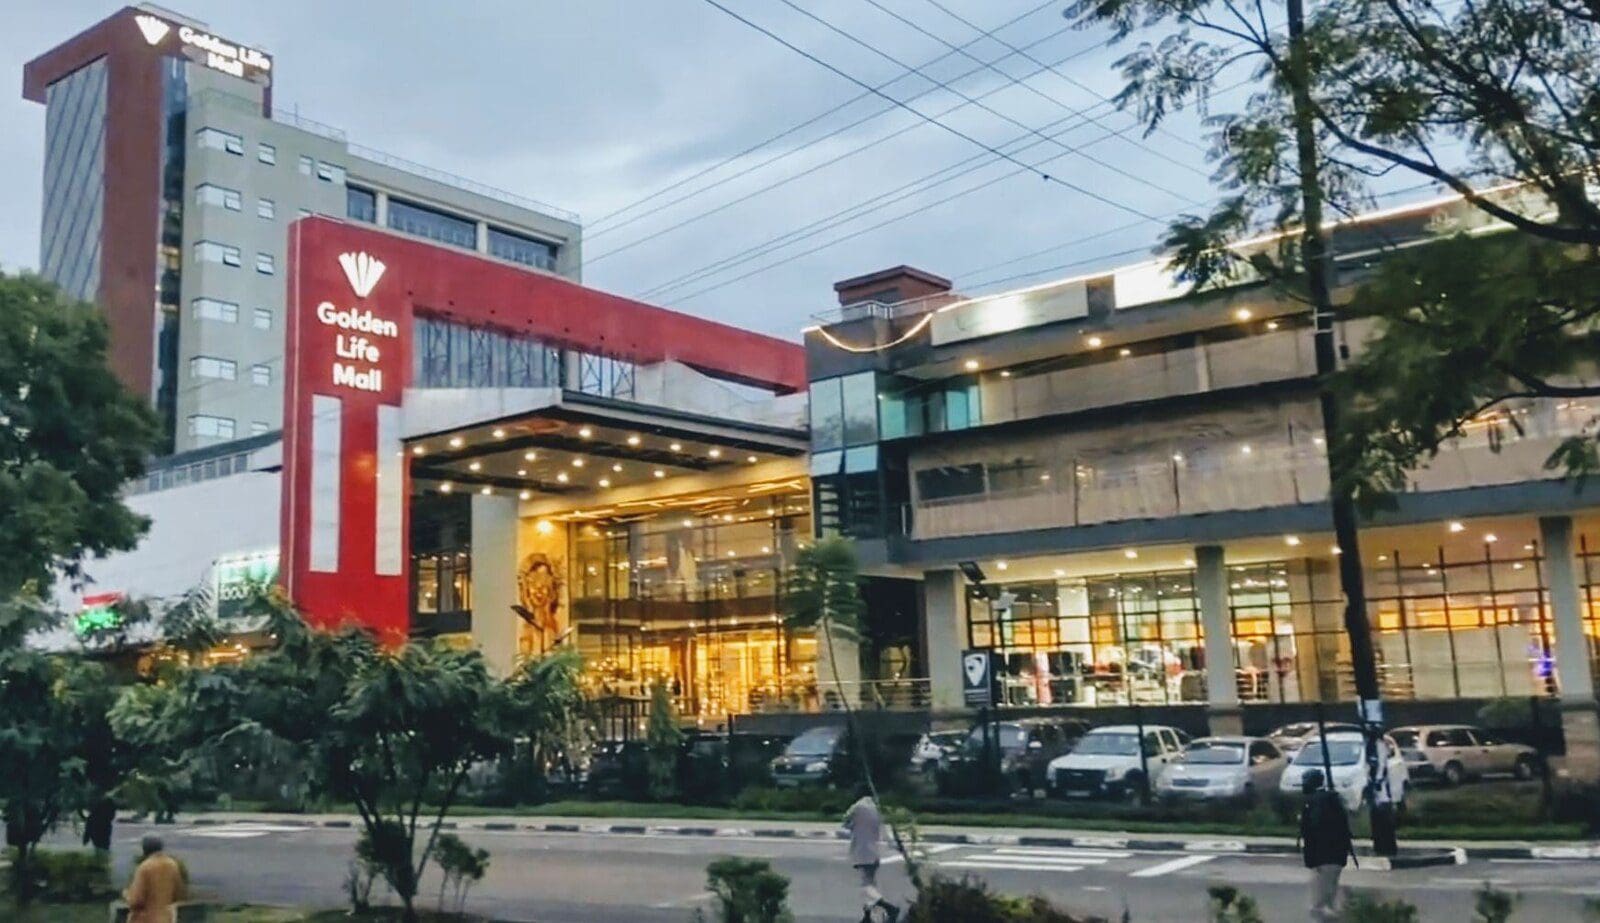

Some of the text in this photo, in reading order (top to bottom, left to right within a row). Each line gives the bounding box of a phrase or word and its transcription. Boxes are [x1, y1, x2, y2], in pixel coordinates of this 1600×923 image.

[179, 27, 270, 70] Golden Life
[207, 51, 243, 77] Mall
[317, 301, 398, 337] Golden
[336, 334, 380, 362] Life
[332, 362, 382, 391] Mall
